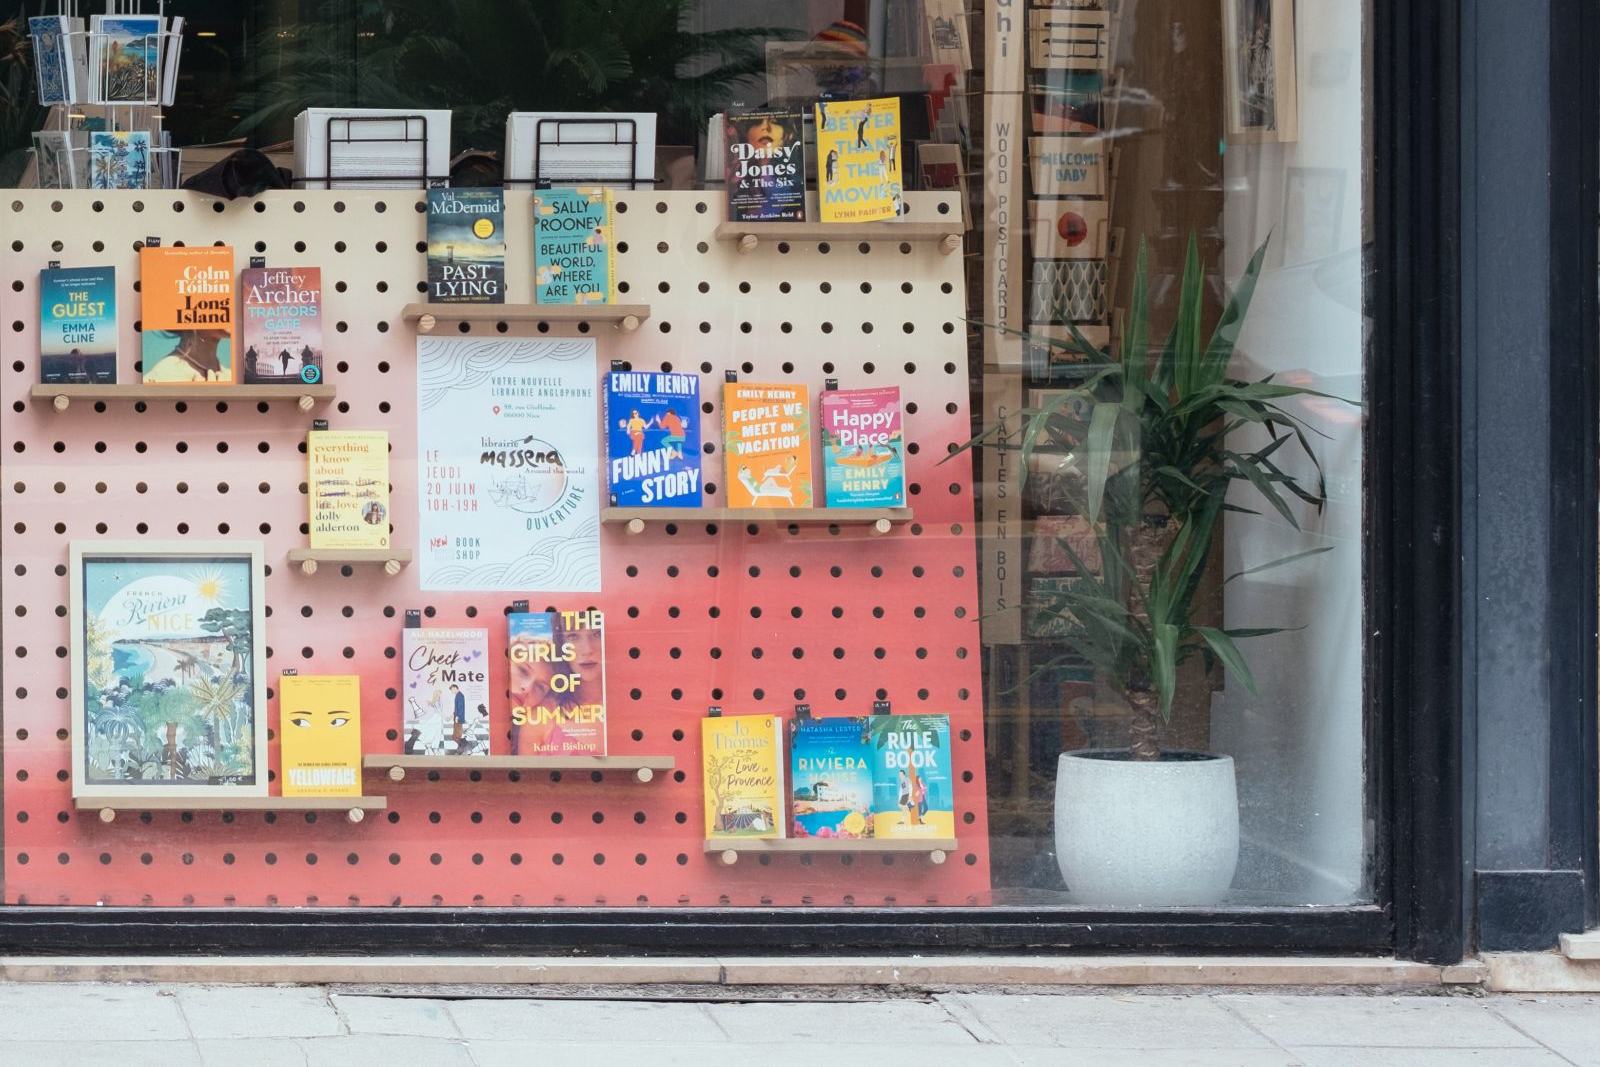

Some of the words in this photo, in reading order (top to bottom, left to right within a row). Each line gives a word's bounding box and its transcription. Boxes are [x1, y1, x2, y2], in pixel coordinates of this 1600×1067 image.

[730, 141, 801, 163] Daisy
[1042, 151, 1100, 166] WELCOME
[735, 161, 797, 178] Jones
[1056, 168, 1088, 182] BABY
[739, 180, 750, 189] &
[752, 178, 775, 188] The
[775, 177, 794, 188] Six
[441, 192, 455, 201] Val
[431, 199, 500, 215] McDermid
[552, 200, 590, 214] SALLY
[834, 209, 856, 219] LYNN
[540, 217, 602, 232] ROONEY
[541, 242, 603, 255] BEAUTIFUL
[550, 256, 596, 268] WORLD,
[183, 265, 230, 280] Colm
[260, 271, 306, 288] Jeffrey
[442, 265, 491, 280] PAST
[552, 270, 592, 282] WHERE
[175, 279, 230, 294] Tóibín
[435, 280, 498, 297] LYING
[545, 285, 568, 297] ARE
[573, 283, 600, 294] YOU
[68, 292, 89, 302] THE
[245, 284, 320, 304] Archer
[52, 302, 106, 318] GUEST
[185, 295, 230, 311] Long
[176, 309, 230, 324] Island
[248, 306, 318, 318] TRAITORS
[62, 323, 96, 333] EMMA
[264, 319, 302, 330] GATE
[63, 334, 95, 344] CLINE
[491, 376, 517, 386] VOTRE
[521, 377, 563, 387] NOUVELLE
[612, 373, 651, 393] EMILY
[656, 374, 697, 395] HENRY
[491, 388, 534, 397] LIBRAIRIE
[538, 388, 593, 398] ANGLOPHONE
[736, 389, 764, 399] EMILY
[767, 390, 797, 399] HENRY
[732, 405, 780, 423] PEOPLE
[783, 402, 803, 417] WE
[832, 409, 894, 430] Happy
[741, 422, 777, 438] MEET
[780, 422, 795, 433] ON
[481, 437, 519, 448] librairie
[840, 429, 889, 446] Place
[314, 442, 369, 454] everything
[736, 435, 800, 455] VACATION
[323, 454, 352, 463] know
[426, 449, 439, 463] LE
[315, 465, 345, 475] about
[612, 446, 673, 484] FUNNY
[427, 466, 461, 479] JEUDI
[845, 467, 886, 479] EMILY
[427, 482, 441, 495] 20
[448, 482, 476, 495] JUIN
[641, 468, 700, 503] STORY
[842, 479, 889, 492] HENRY
[337, 500, 359, 509] love
[427, 499, 478, 512] 10H-19H
[526, 485, 585, 531] OUVERTURE
[315, 511, 340, 521] dolly
[315, 523, 360, 532] alderton
[455, 537, 481, 547] BOOK
[455, 550, 481, 560] SHOP
[116, 593, 188, 626] Riviera
[147, 614, 193, 631] NICE
[560, 610, 603, 631] THE
[408, 645, 462, 672] Check
[510, 642, 577, 664] GIRLS
[441, 669, 485, 682] Mate
[550, 673, 582, 694] OF
[512, 704, 606, 726] SUMMER
[734, 719, 750, 737] Jo
[835, 725, 861, 733] LESTER
[900, 719, 918, 731] The
[533, 742, 560, 753] Katie
[562, 741, 597, 753] Bishop
[710, 731, 770, 750] Thomas
[887, 731, 933, 750] RULE
[798, 757, 868, 771] RIVIERA
[885, 750, 938, 769] BOOK
[735, 760, 760, 774] Love
[288, 767, 356, 787] YELLOWFACE
[727, 774, 775, 790] Provence
